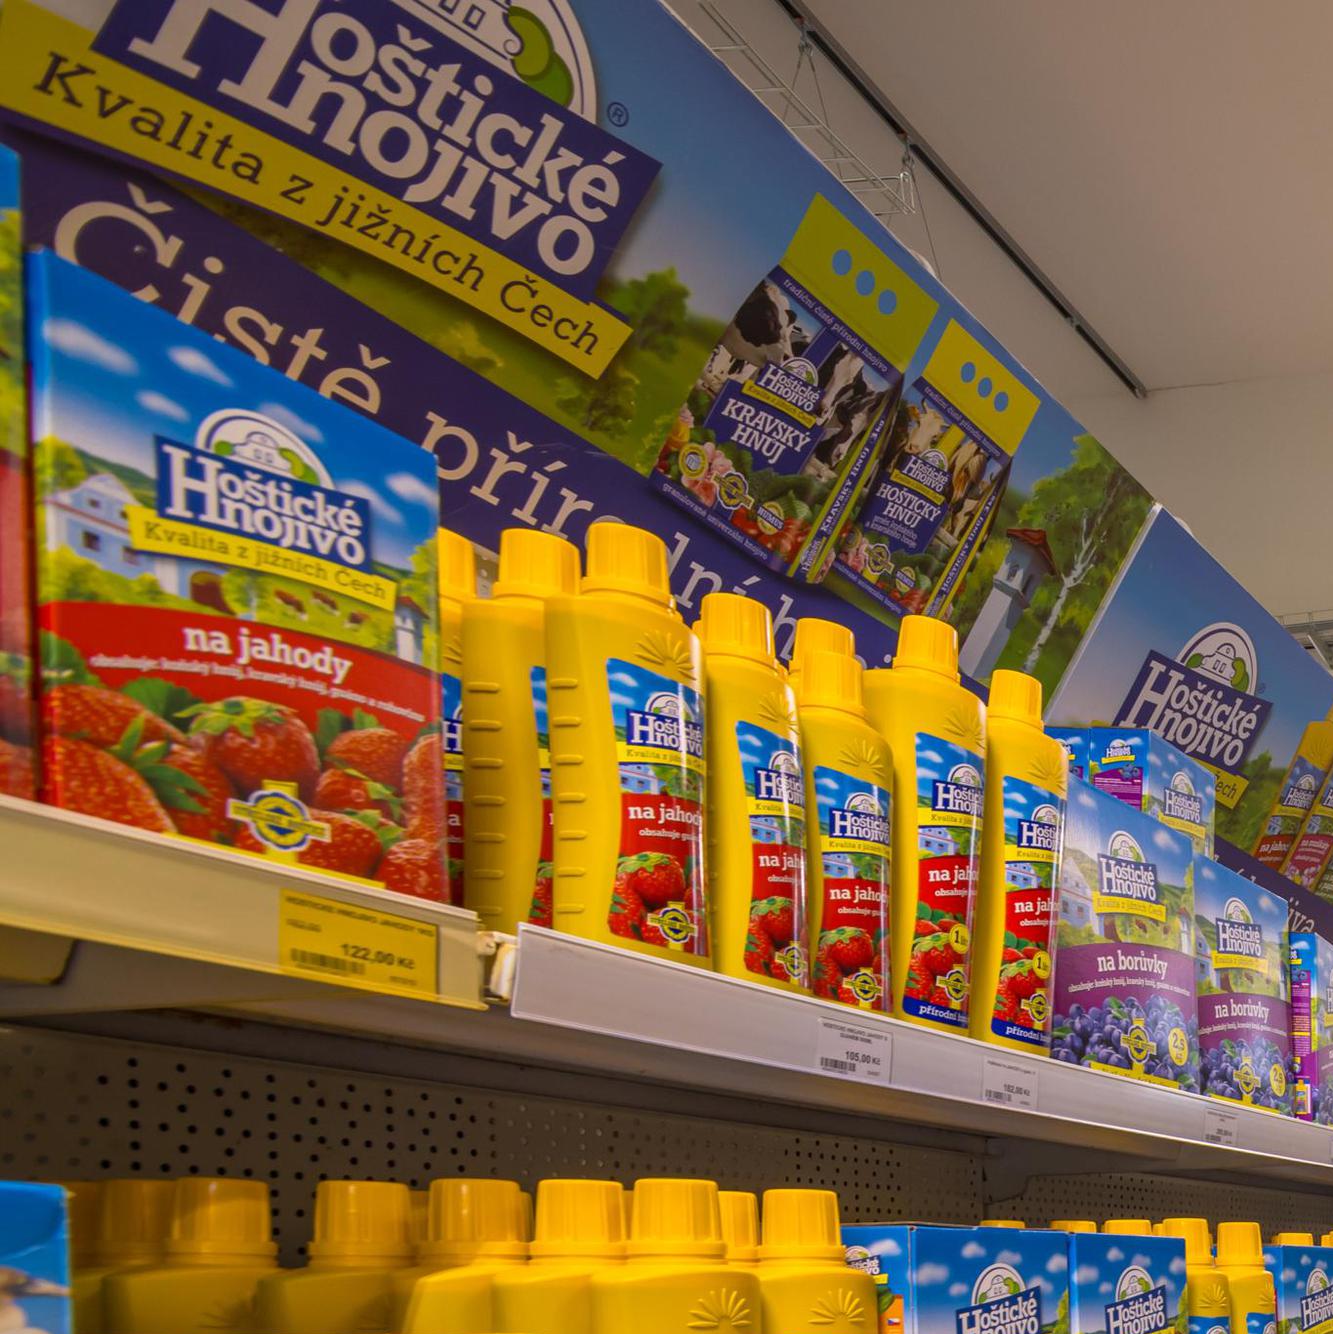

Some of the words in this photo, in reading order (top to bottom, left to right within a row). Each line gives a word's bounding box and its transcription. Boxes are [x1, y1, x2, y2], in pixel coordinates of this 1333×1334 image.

[32, 53, 262, 185] Kvalita
[279, 169, 314, 205] z
[315, 183, 485, 293] jižních
[499, 277, 602, 357] Čech
[720, 397, 811, 453] KRAVSKÝ
[162, 444, 363, 535] Hoštické
[876, 483, 943, 522] HOŠTICKÝ
[144, 522, 229, 555] Kvalita
[237, 543, 249, 560] z
[254, 545, 328, 583] jižních
[334, 569, 387, 601] Čech
[183, 626, 232, 655] na
[236, 627, 353, 684] jahody
[1125, 660, 1258, 741] Hoštické
[628, 805, 655, 820] na
[830, 888, 851, 902] na
[1097, 953, 1115, 972] na
[1118, 950, 1168, 980] borůvky
[919, 1003, 958, 1021] přírodní
[1215, 1003, 1229, 1019] na
